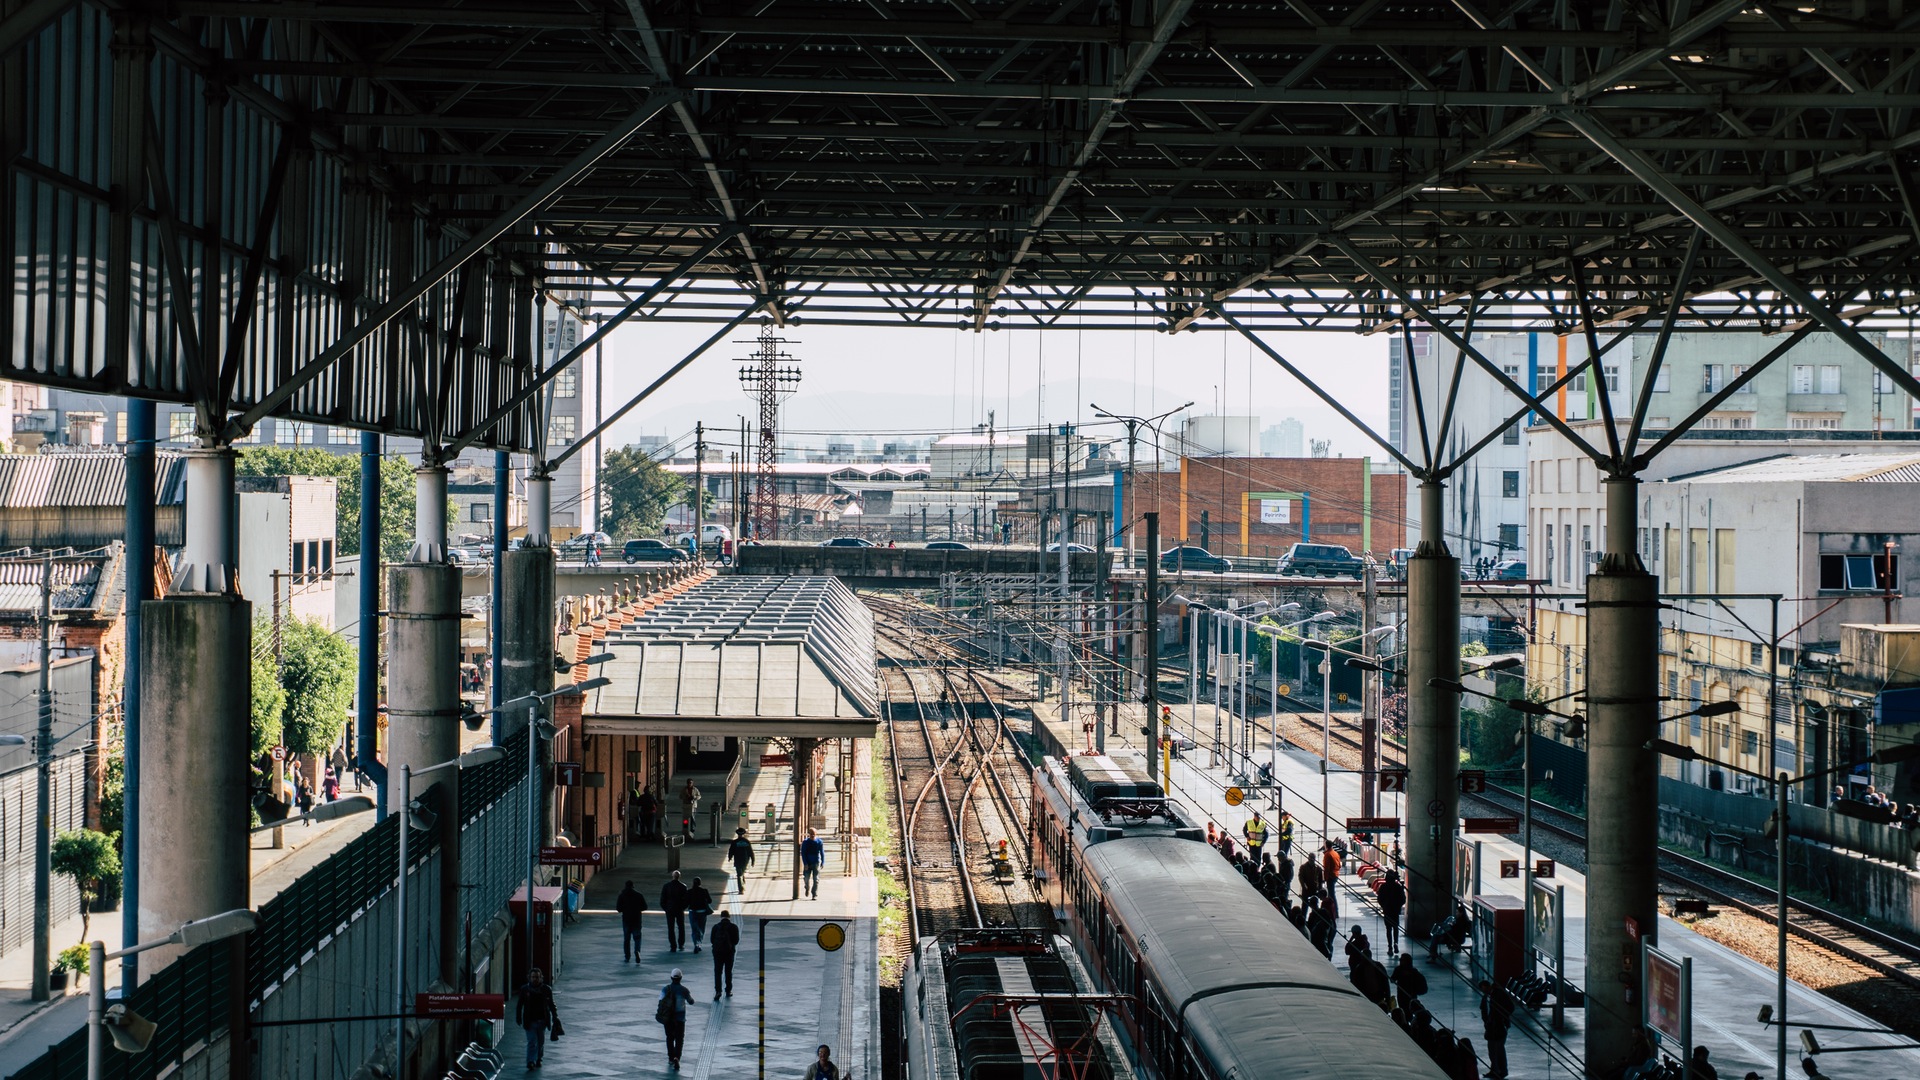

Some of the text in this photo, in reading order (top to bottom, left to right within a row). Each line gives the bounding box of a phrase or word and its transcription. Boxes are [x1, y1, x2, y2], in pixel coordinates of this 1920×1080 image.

[1338, 693, 1347, 701] 40
[563, 769, 573, 786] 1
[1386, 775, 1398, 791] 2
[1467, 777, 1479, 792] 3
[1505, 866, 1515, 877] 2
[1541, 866, 1551, 877] 3
